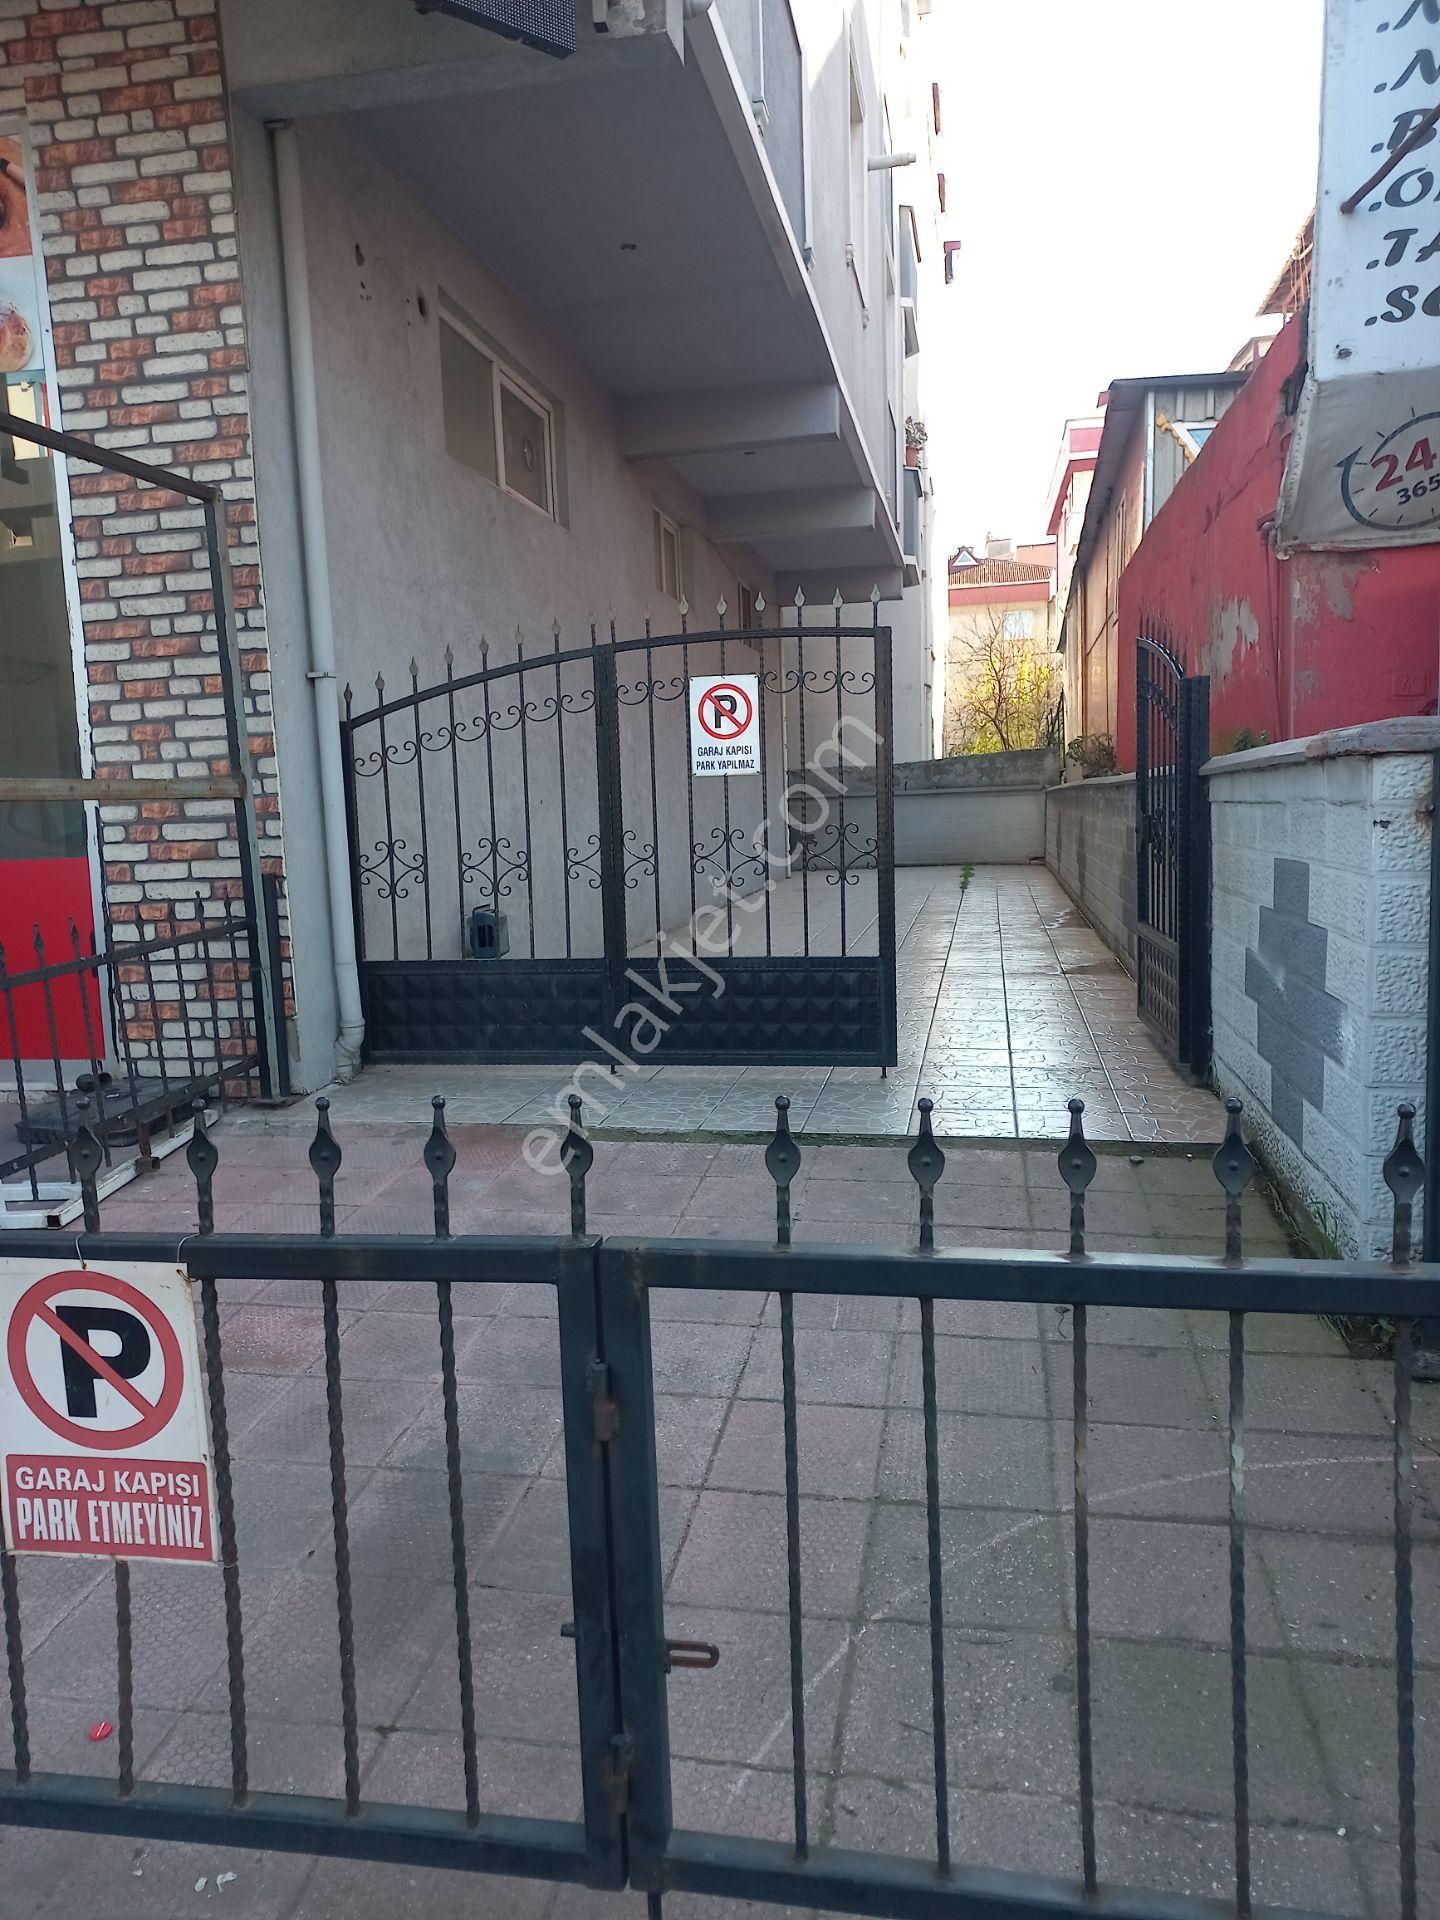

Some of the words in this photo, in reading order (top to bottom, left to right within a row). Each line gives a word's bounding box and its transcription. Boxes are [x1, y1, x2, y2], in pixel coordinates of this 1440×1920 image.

[1371, 437, 1437, 492] 24
[696, 760, 716, 771] PARK
[717, 759, 755, 770] YAPILMAZ
[697, 746, 724, 757] GARAJ
[726, 745, 752, 756] KAPISI
[15, 1466, 105, 1493] GARAJ
[113, 1470, 200, 1498] KAPISI
[16, 1497, 82, 1543] PARK
[87, 1495, 206, 1550] ETMEYİNİZ
